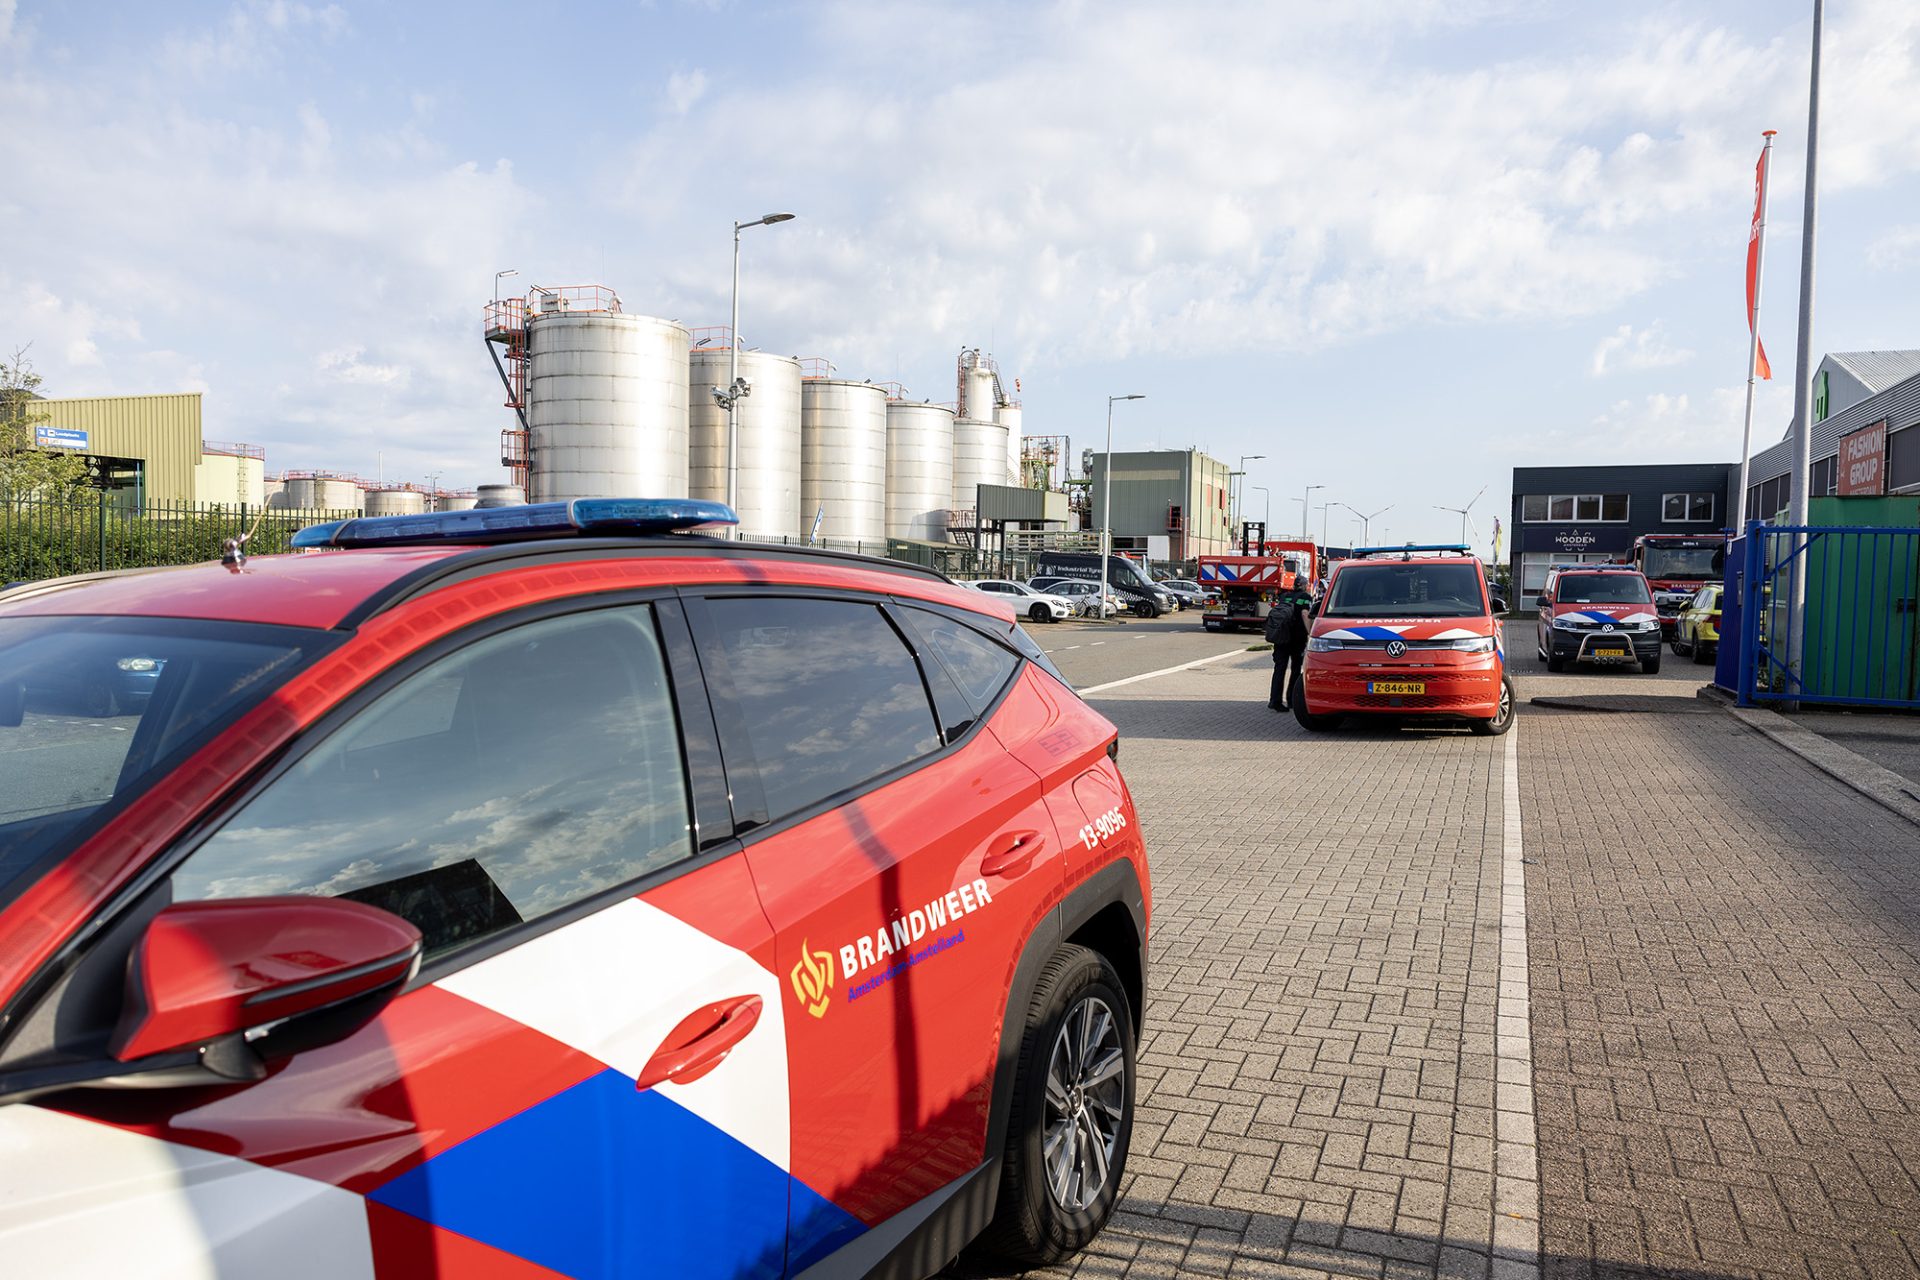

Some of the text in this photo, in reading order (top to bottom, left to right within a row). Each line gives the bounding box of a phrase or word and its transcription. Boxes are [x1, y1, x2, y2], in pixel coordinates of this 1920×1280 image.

[1848, 428, 1883, 461] FASHION
[1850, 457, 1877, 486] GROUP
[1555, 536, 1596, 544] WOODEN
[1057, 565, 1088, 573] Industrial
[1375, 683, 1422, 693] Z-846-NR
[1079, 806, 1126, 850] 13-9096
[839, 878, 992, 979] BRANDWEER
[848, 928, 966, 1003] Amsterdam-Amstelland
